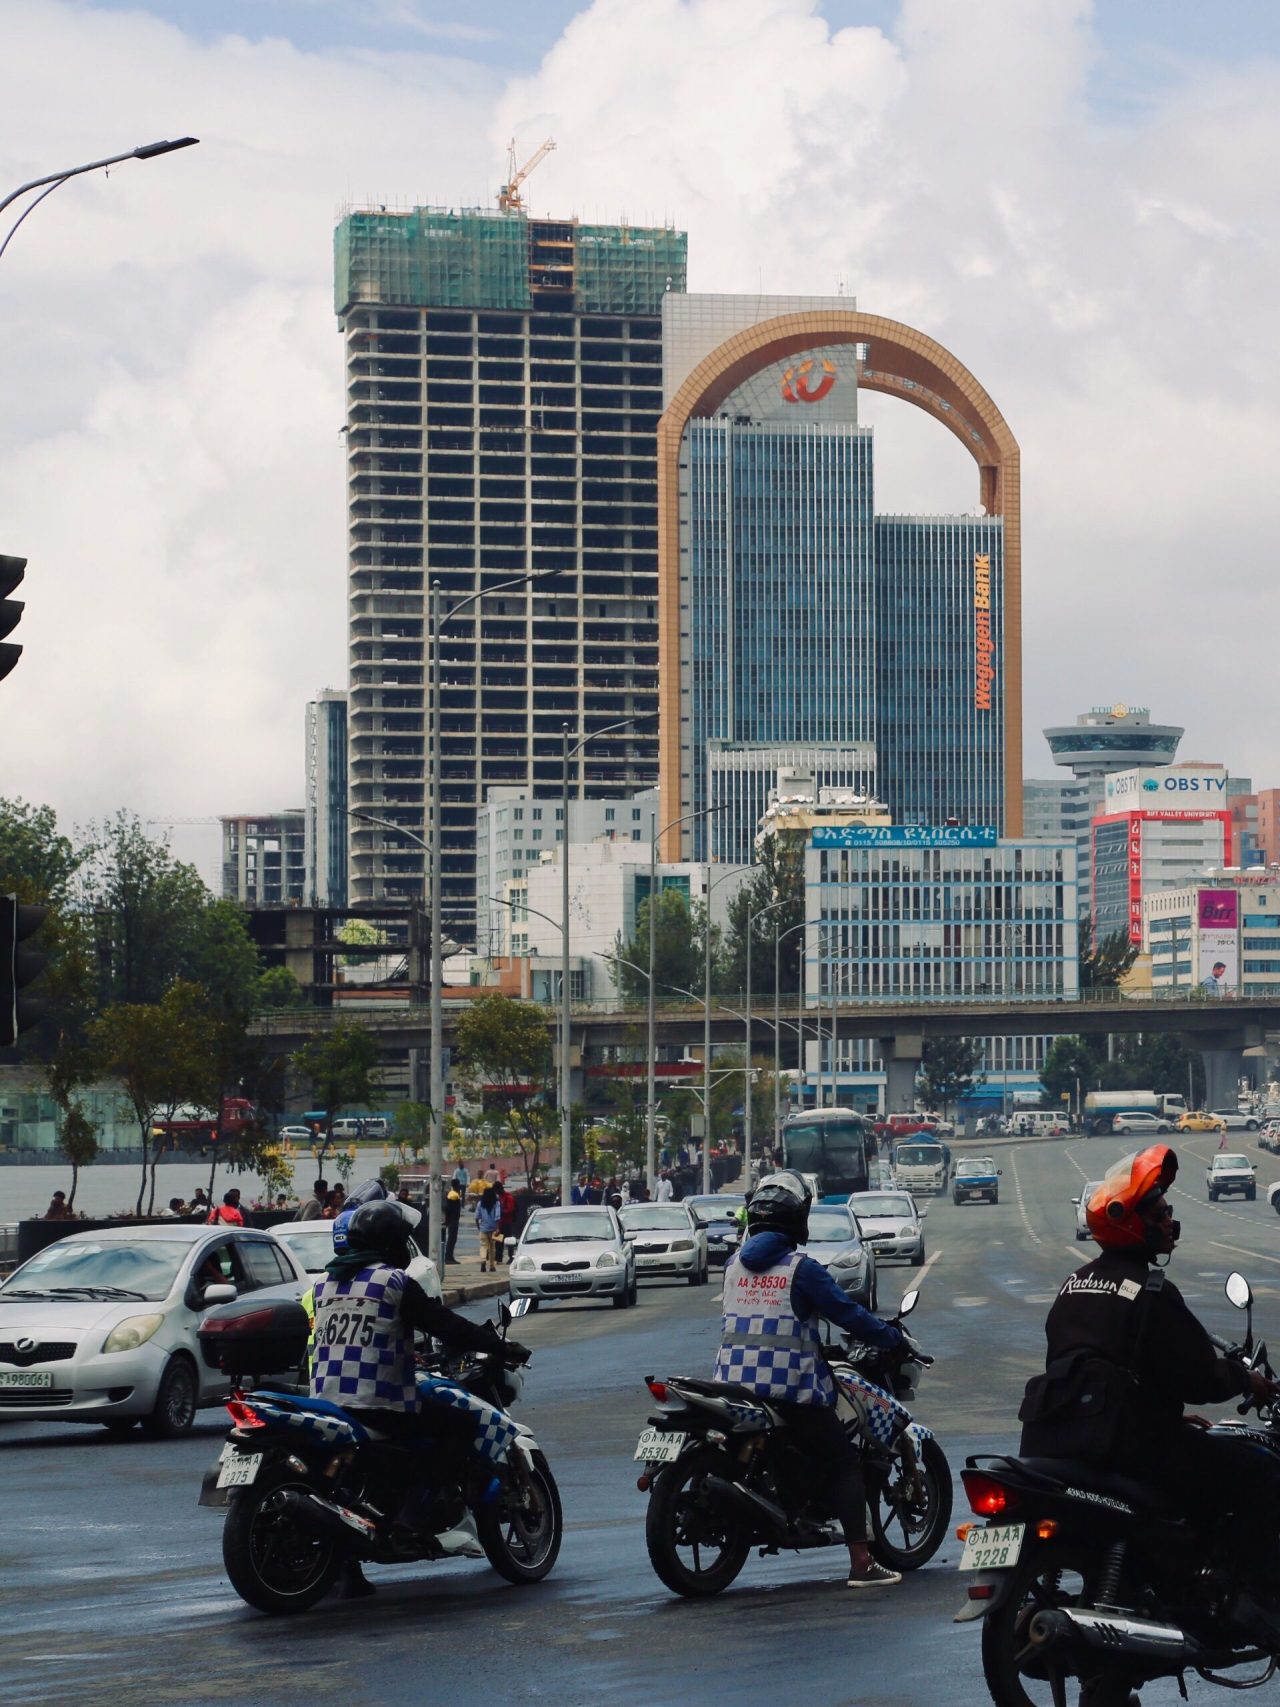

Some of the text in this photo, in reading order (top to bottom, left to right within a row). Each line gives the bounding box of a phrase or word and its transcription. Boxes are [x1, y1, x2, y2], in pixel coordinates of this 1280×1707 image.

[975, 553, 996, 710] Wegagen Bank
[1116, 775, 1138, 795] OBS TV
[1164, 777, 1226, 791] OBS TV
[738, 1275, 787, 1290] AA 3-8530
[1060, 1272, 1117, 1295] Radisson
[327, 1313, 376, 1347] 6275
[640, 1447, 669, 1460] 8530
[972, 1547, 1009, 1568] 3228
